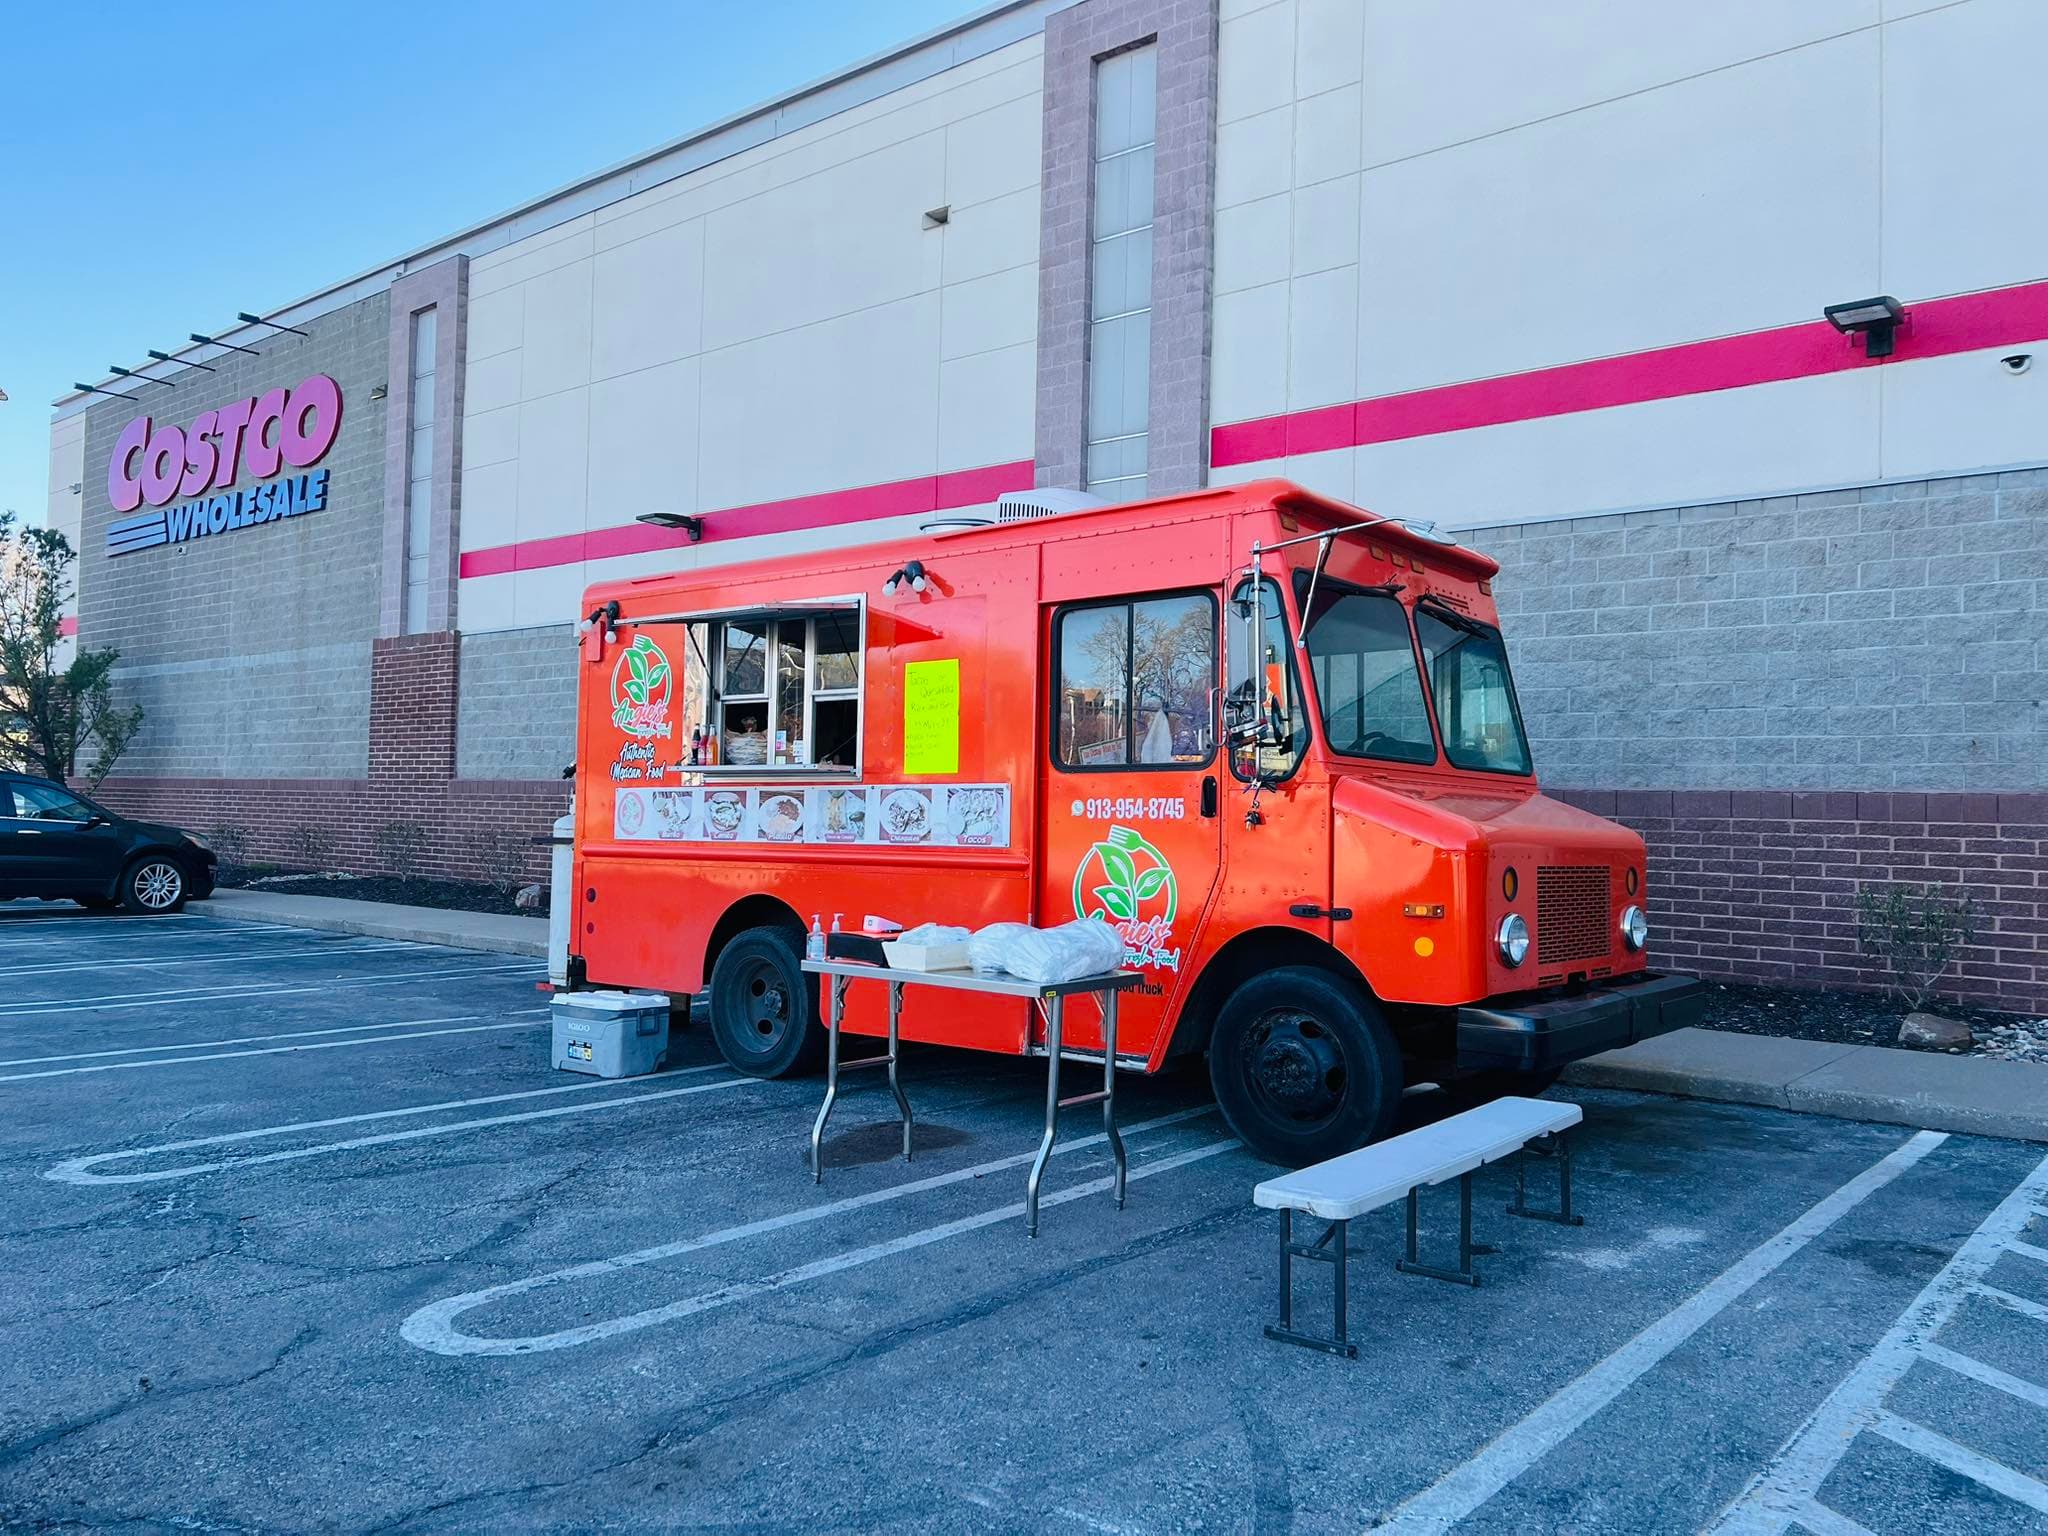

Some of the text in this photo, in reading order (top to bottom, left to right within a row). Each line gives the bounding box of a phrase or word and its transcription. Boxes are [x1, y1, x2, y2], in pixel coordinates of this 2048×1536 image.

[107, 374, 343, 512] COSTCO
[165, 468, 330, 543] WHOLESALE
[620, 740, 656, 762] Authentic
[610, 758, 667, 782] Mexican Food
[1086, 797, 1185, 820] 913-954-8745
[962, 835, 987, 845] Tacos
[1151, 948, 1180, 972] Food
